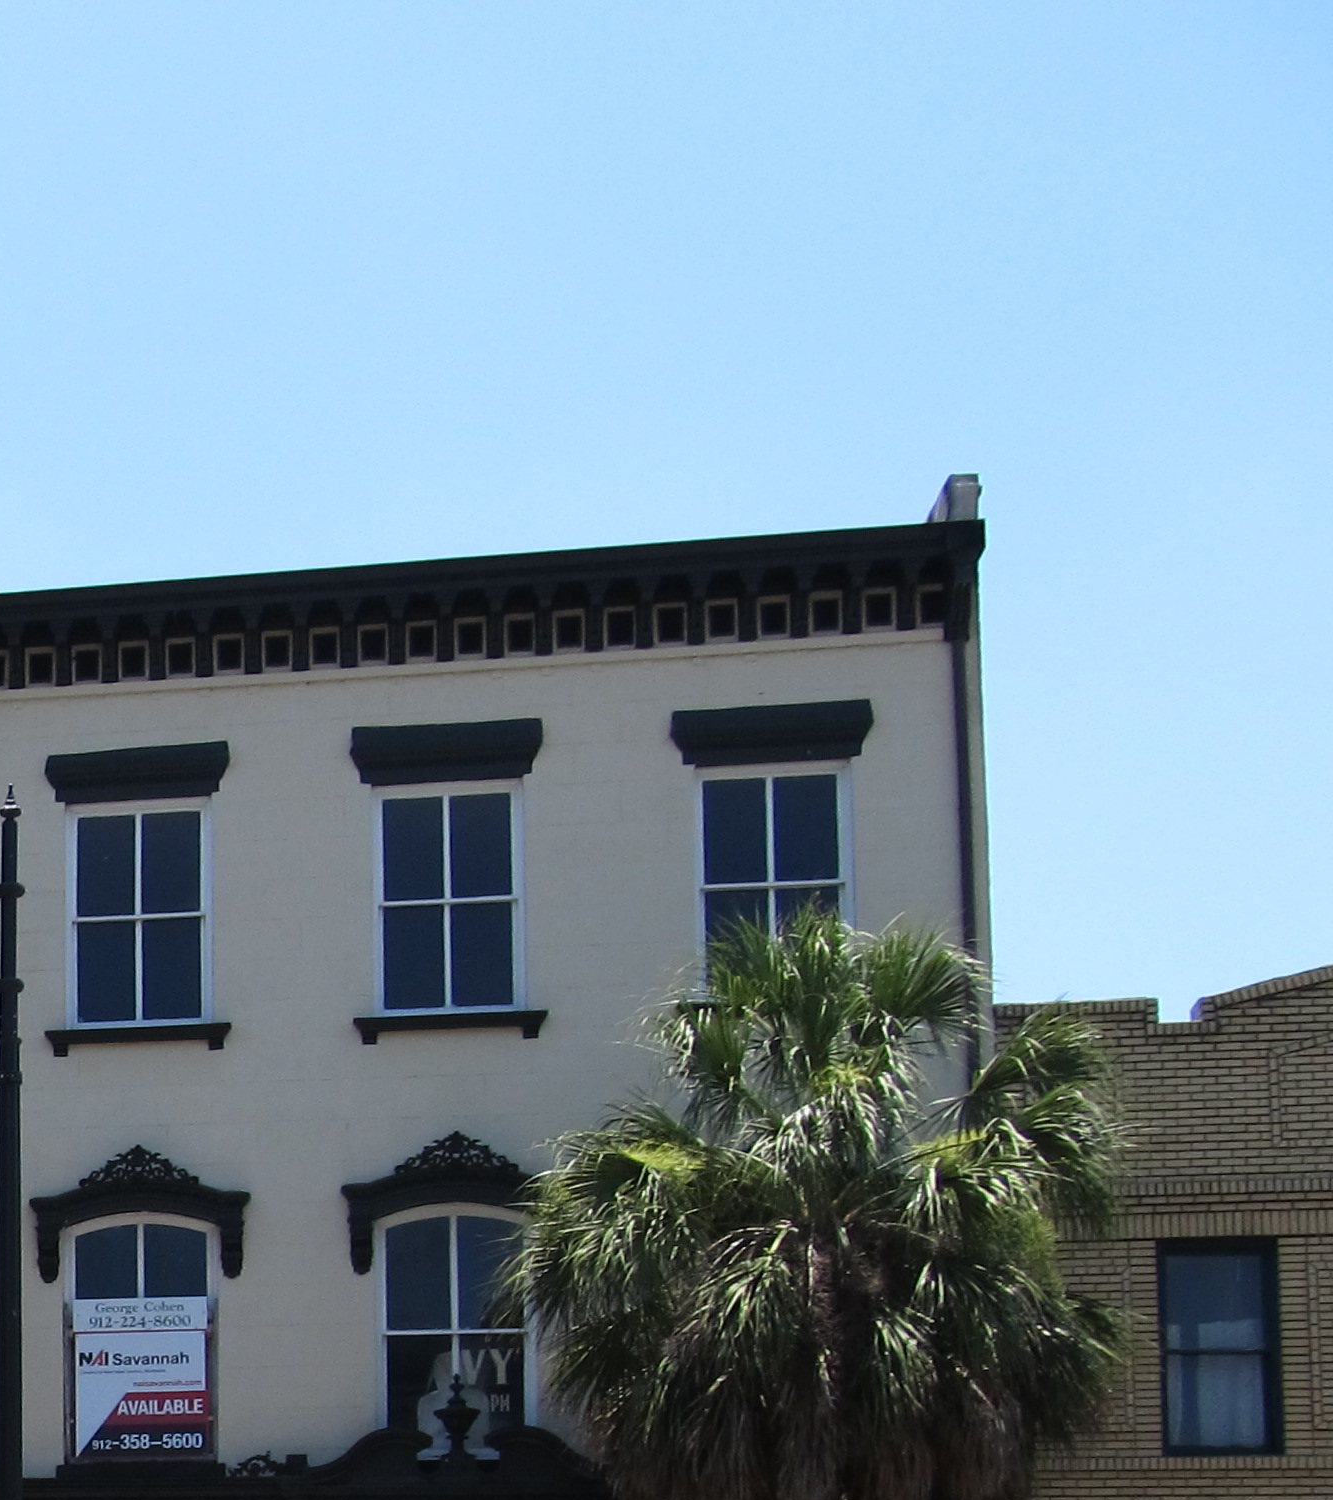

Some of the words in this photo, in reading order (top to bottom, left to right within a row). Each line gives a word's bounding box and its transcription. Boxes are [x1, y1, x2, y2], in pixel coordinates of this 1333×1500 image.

[95, 1303, 138, 1314] George
[144, 1301, 184, 1312] Cohen
[89, 1315, 191, 1328] 912-224-8600
[79, 1349, 109, 1367] NAI
[112, 1352, 189, 1366] Savannah
[117, 1399, 203, 1415] AVAILABLE
